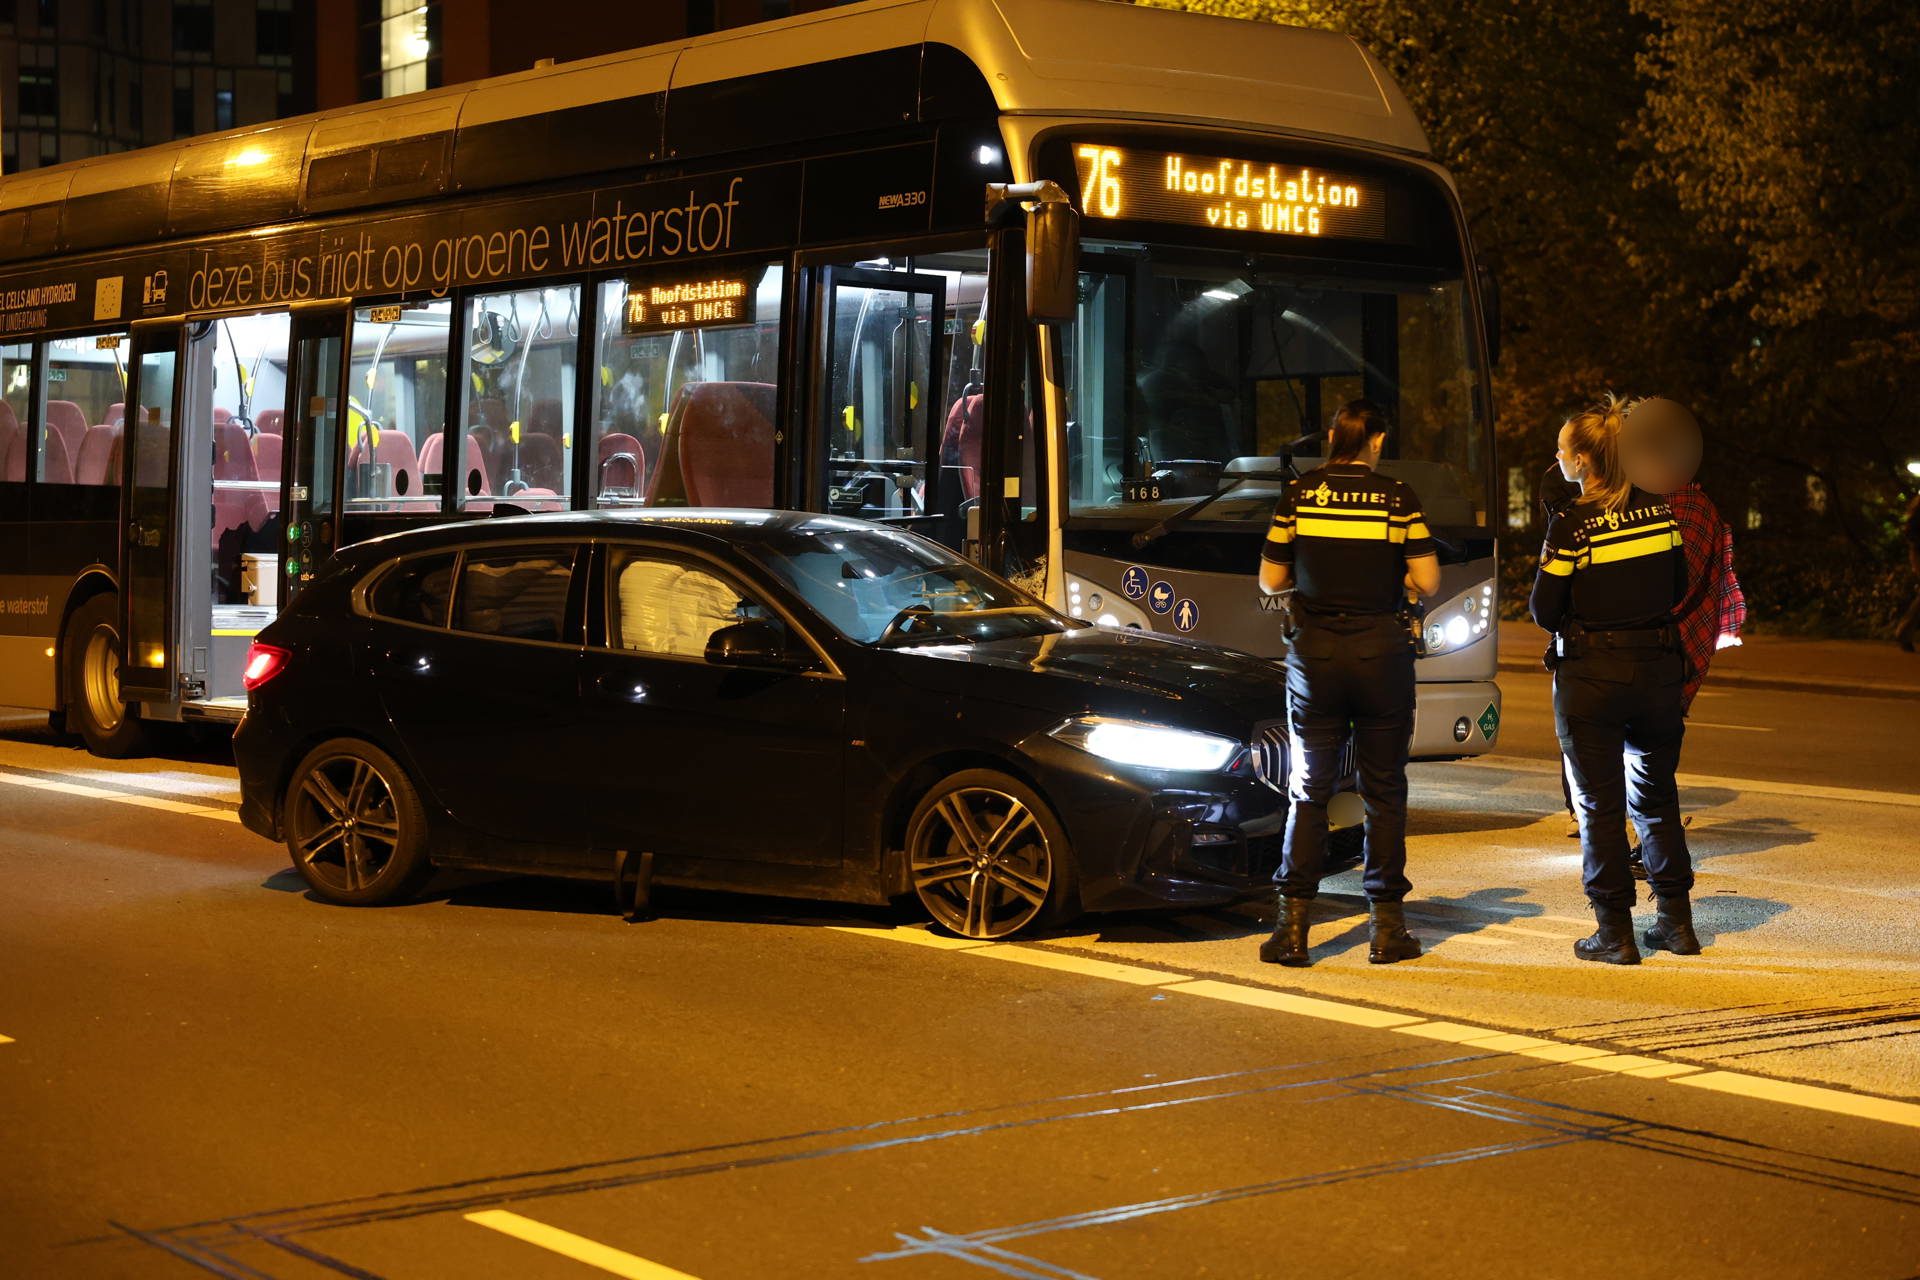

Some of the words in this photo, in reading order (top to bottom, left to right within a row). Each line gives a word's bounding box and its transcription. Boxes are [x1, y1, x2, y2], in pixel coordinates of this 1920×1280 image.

[1079, 147, 1121, 217] 76
[1166, 156, 1358, 207] Hoofdstation
[1207, 201, 1248, 228] via
[1260, 202, 1320, 235] UMCG
[190, 252, 253, 310] deze
[261, 243, 312, 301] bus
[319, 231, 376, 298] rijdt
[382, 242, 423, 300] op
[431, 225, 550, 298] groene
[560, 177, 743, 267] waterstof
[5, 290, 25, 309] CELLS
[26, 287, 40, 307] AND
[41, 282, 77, 305] HYDROGEN
[651, 280, 743, 305] Hoofdstation
[6, 308, 47, 331] UNDERTAKING
[628, 293, 644, 323] 76
[661, 306, 687, 324] via
[693, 300, 734, 321] UMCG
[1129, 486, 1160, 500] 168
[1305, 487, 1380, 506] POLITIE
[1596, 506, 1659, 530] POLITIE
[7, 595, 48, 615] waterstof
